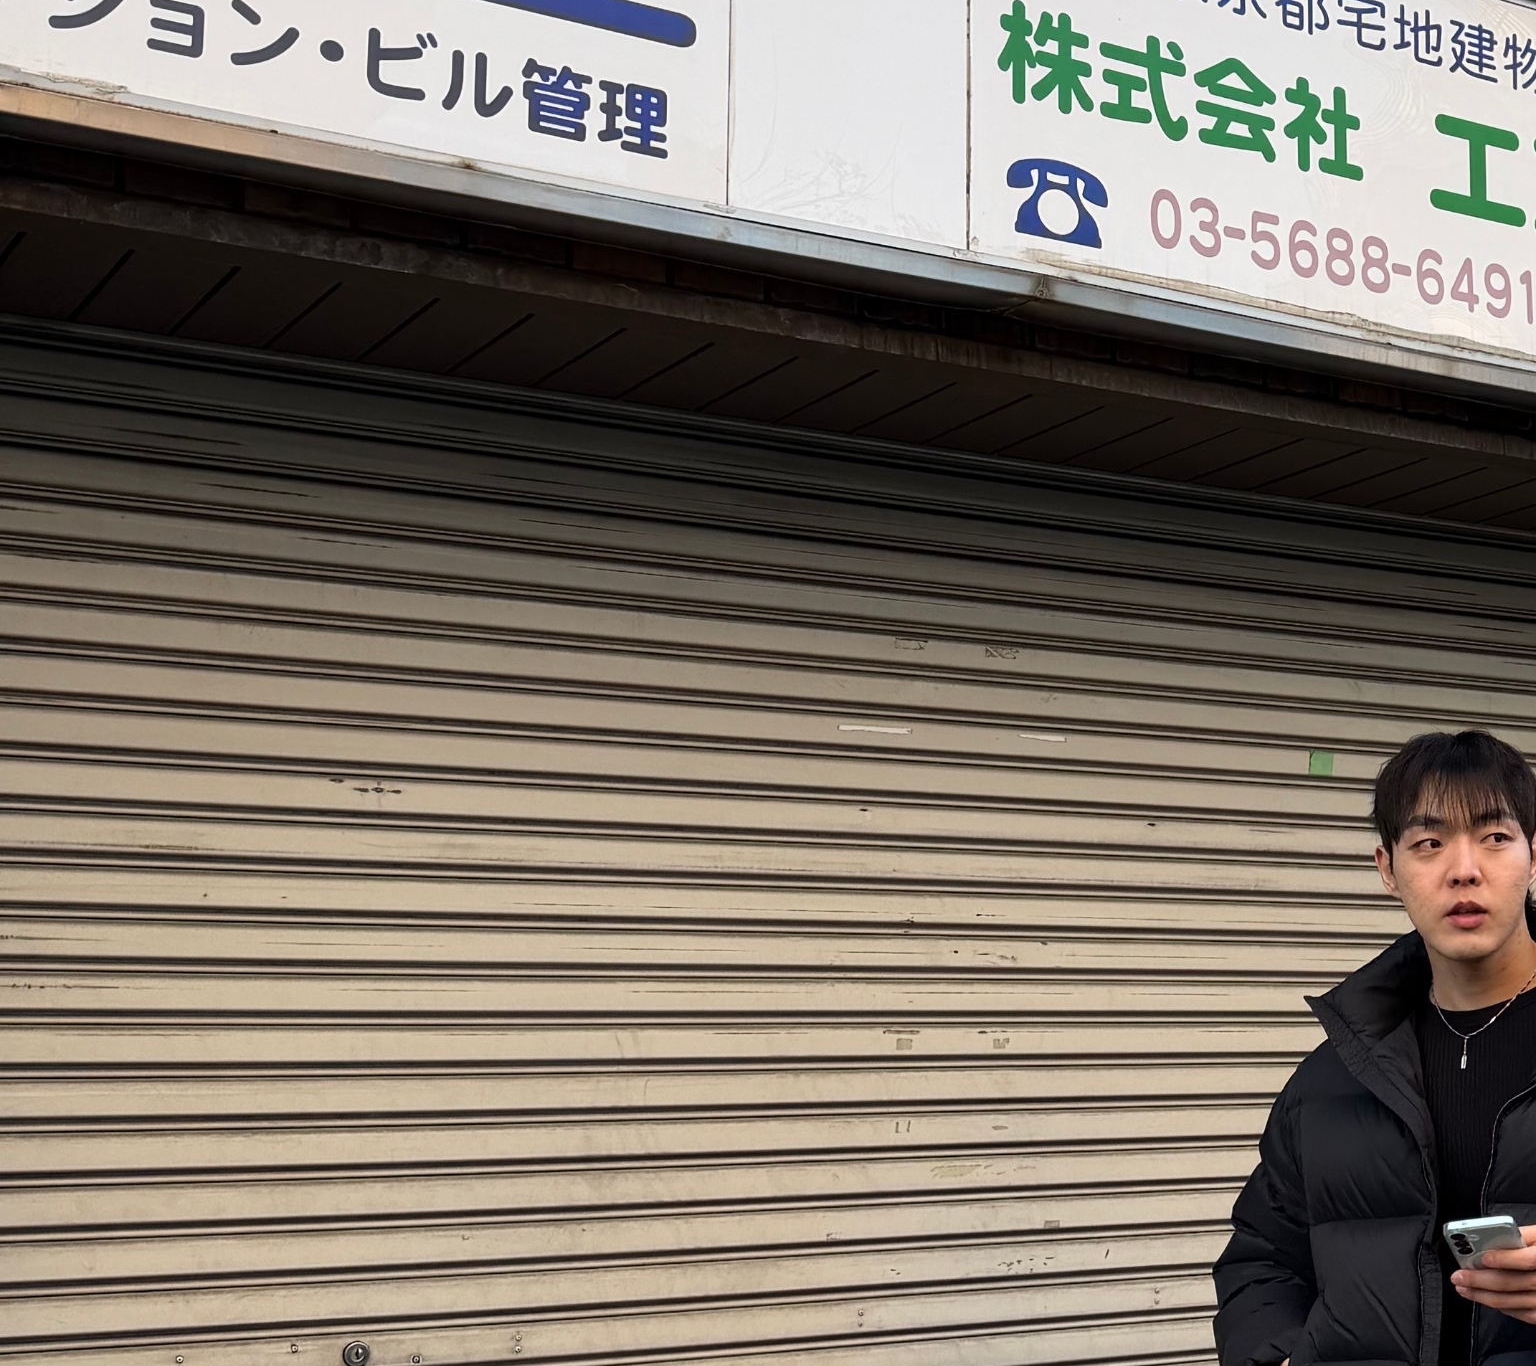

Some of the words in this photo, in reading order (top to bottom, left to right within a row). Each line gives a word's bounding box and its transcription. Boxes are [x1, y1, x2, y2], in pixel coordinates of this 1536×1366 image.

[997, 0, 1363, 181] 株式会社
[1150, 188, 1534, 324] 03-5688-6491
